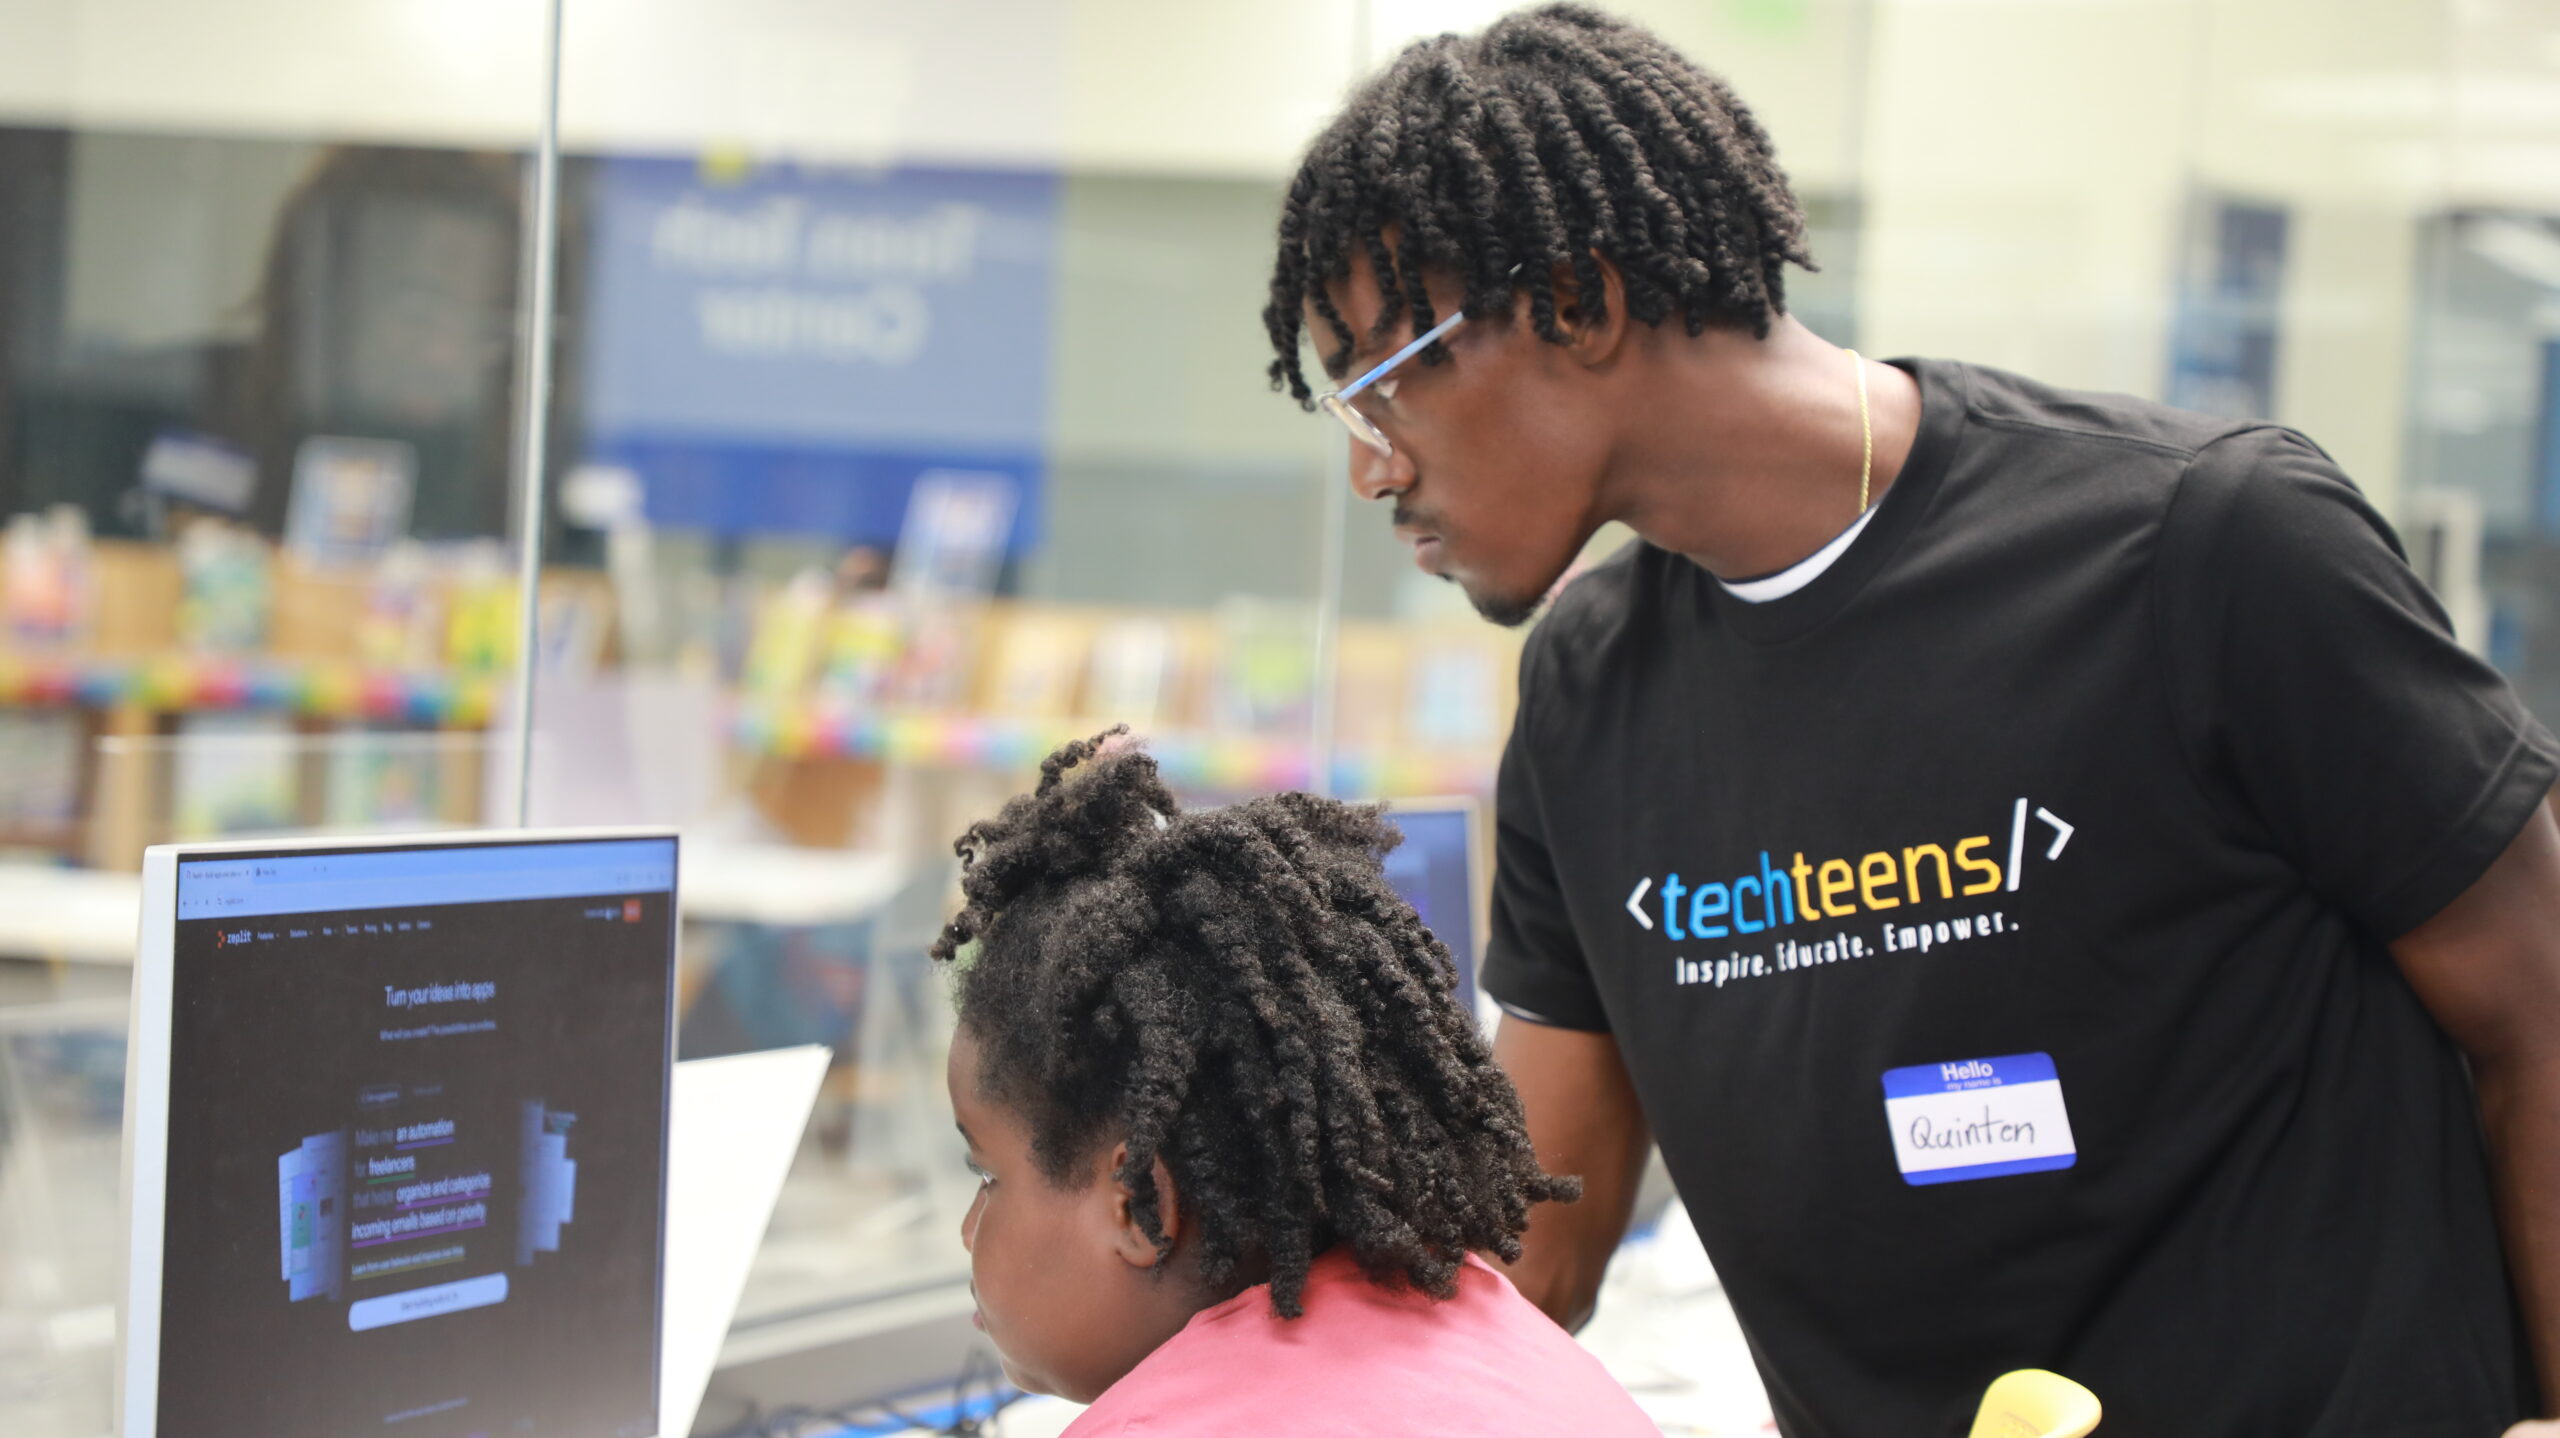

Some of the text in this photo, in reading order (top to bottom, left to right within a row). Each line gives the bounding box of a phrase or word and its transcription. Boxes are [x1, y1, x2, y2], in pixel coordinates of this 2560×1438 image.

[227, 931, 252, 946] replit
[1675, 911, 2020, 988] Inspire. Educate. Empower.
[384, 980, 495, 1010] Turn your ideas into apps
[1941, 1060, 1993, 1081] Hello
[1946, 1077, 2002, 1091] my name is
[396, 1127, 407, 1142] an
[407, 1118, 455, 1141] automation
[1910, 1104, 2036, 1150] Quinten
[368, 1156, 416, 1176] freelancers
[396, 1181, 431, 1206] organize
[432, 1176, 448, 1193] and
[449, 1172, 491, 1197] categorize
[352, 1202, 486, 1240] incoming emails based on priority
